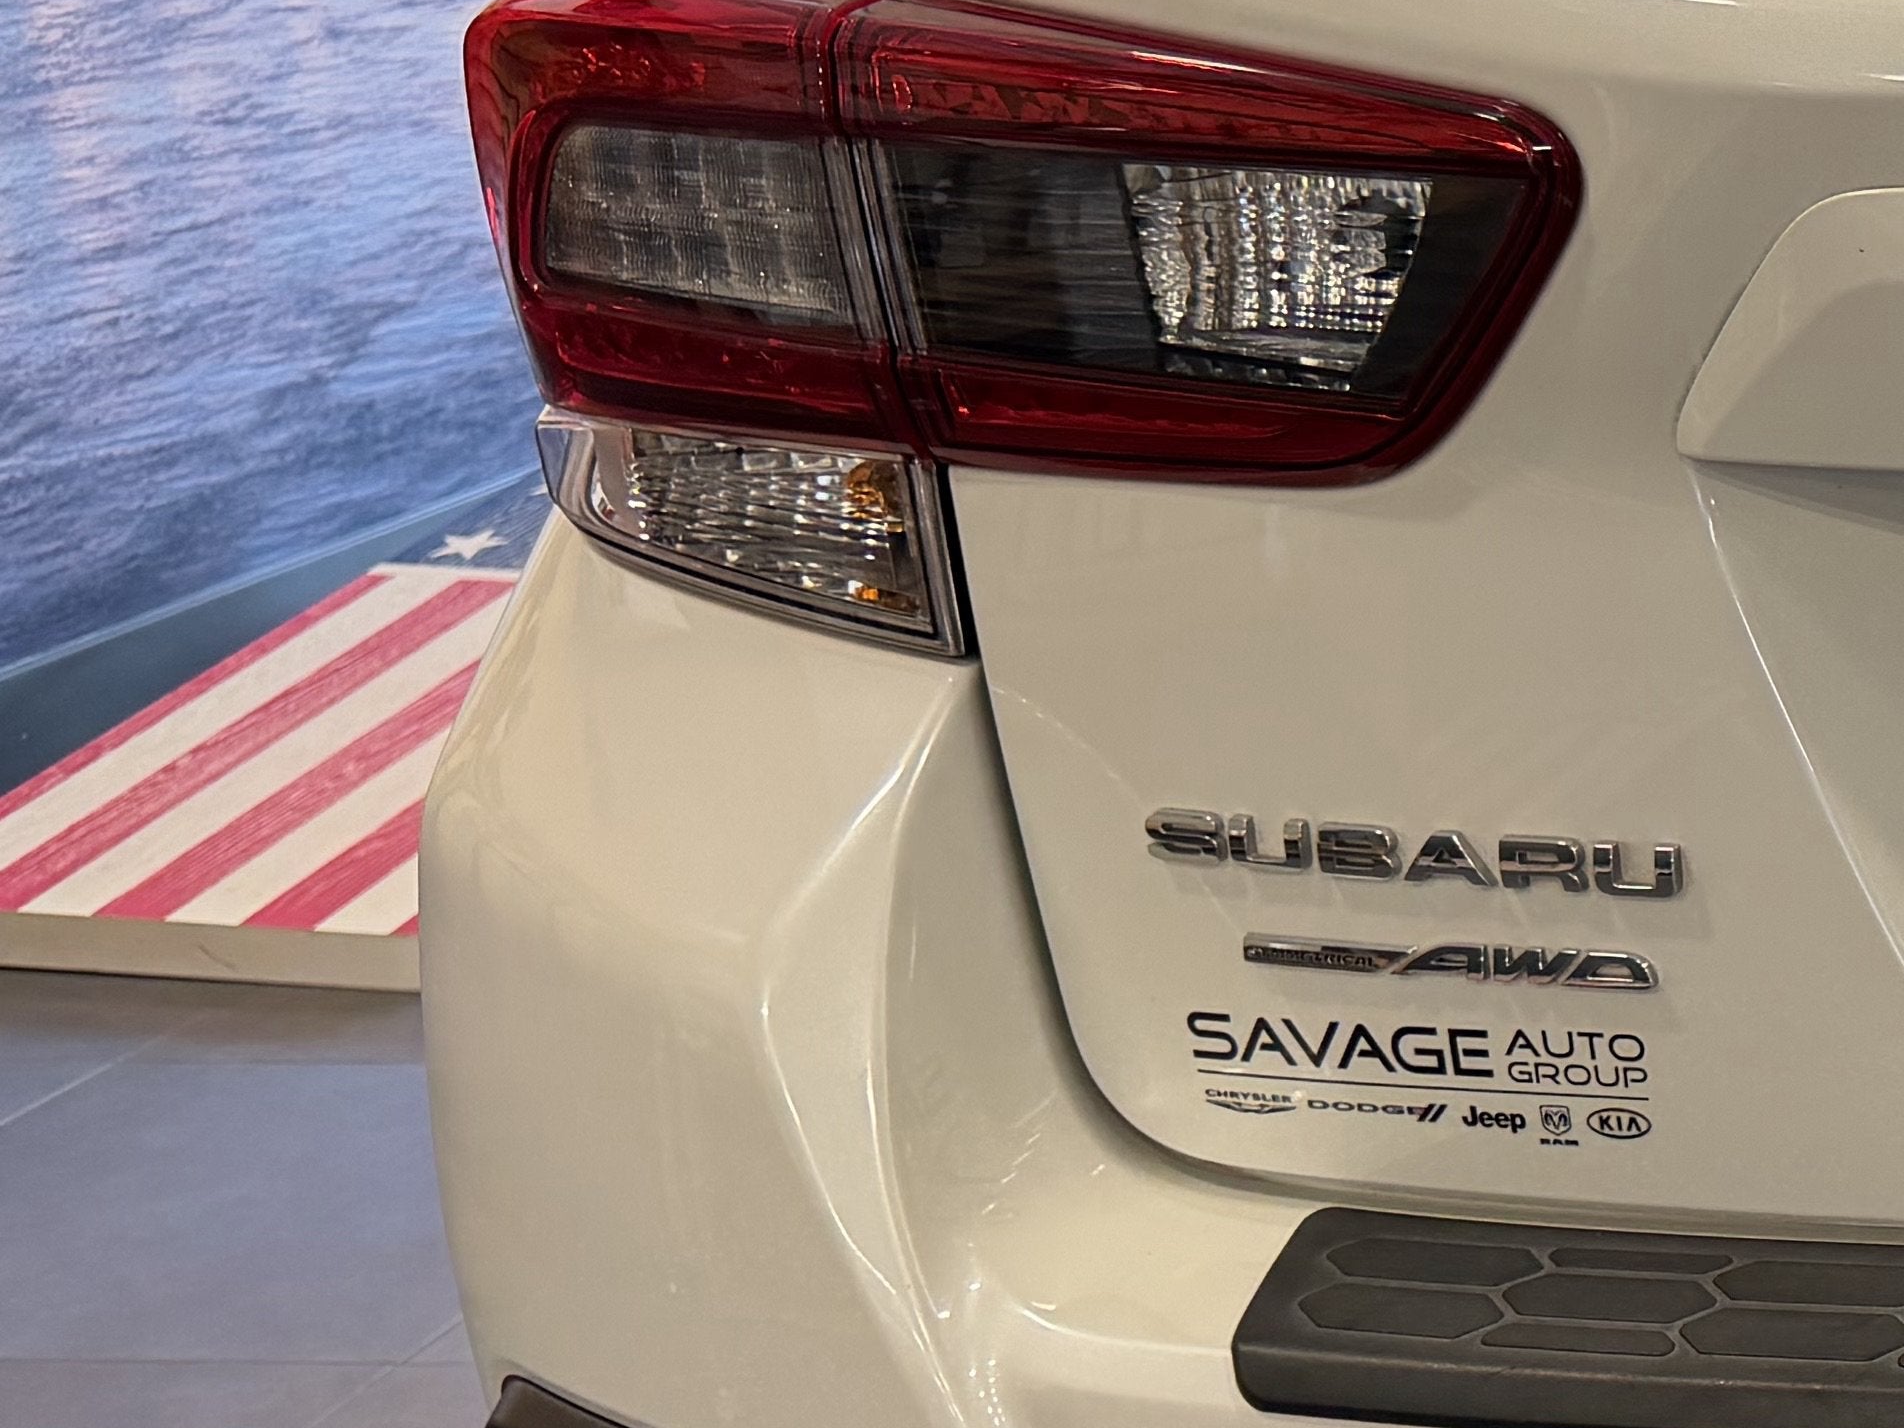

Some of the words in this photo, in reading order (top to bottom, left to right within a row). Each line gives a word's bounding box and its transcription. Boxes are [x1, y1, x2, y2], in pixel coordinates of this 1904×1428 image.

[1145, 807, 1684, 898] SUBARU
[1392, 943, 1660, 990] AWD
[1186, 1011, 1495, 1078] SAVAGE
[1504, 1028, 1646, 1061] AUTO
[1507, 1060, 1648, 1088] GROUP
[1205, 1088, 1293, 1104] CHRYSLER
[1307, 1099, 1432, 1119] DODGE
[1462, 1105, 1527, 1134] Jeep
